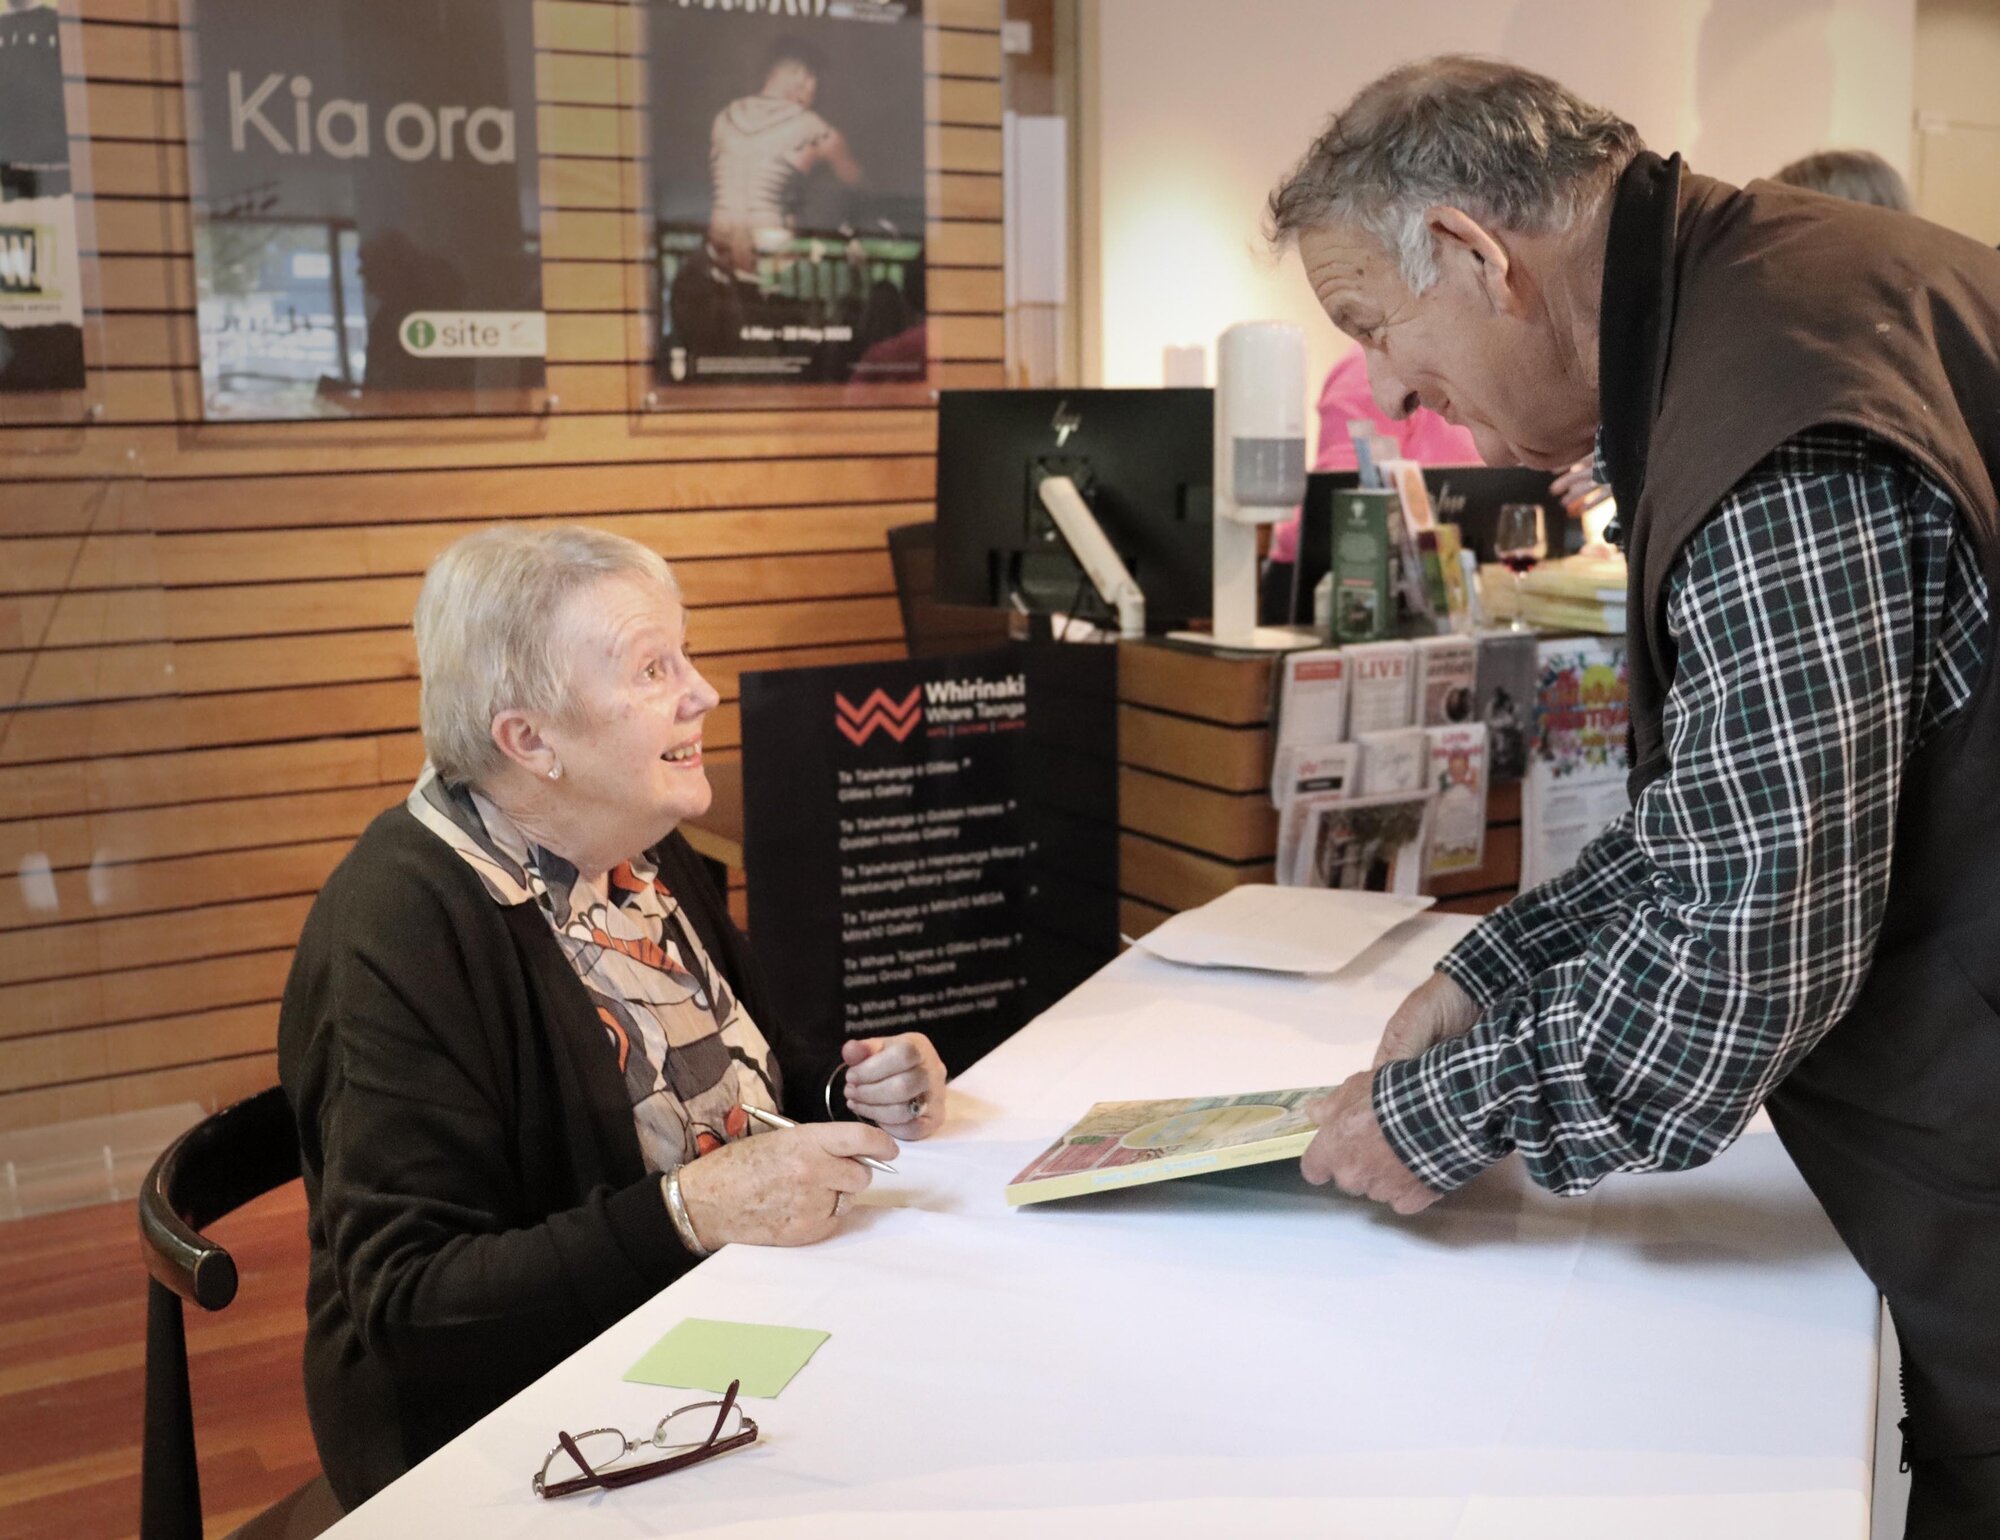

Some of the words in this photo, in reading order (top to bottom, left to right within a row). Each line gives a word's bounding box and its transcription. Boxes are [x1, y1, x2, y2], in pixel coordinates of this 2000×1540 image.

[228, 70, 370, 159] Kia
[384, 101, 516, 165] ora
[442, 319, 500, 348] site
[1357, 660, 1404, 680] LIVE
[925, 673, 1026, 704] Whirinaki
[925, 705, 973, 723] Whare
[975, 701, 1026, 719] Taonga
[838, 771, 853, 784] Te
[838, 787, 872, 802] Gillies
[874, 783, 914, 798] Gallery
[840, 819, 854, 833] Te
[926, 808, 965, 822] Golden
[966, 804, 1003, 816] Homes
[839, 836, 880, 851] Golden
[881, 832, 920, 845] Homes
[922, 826, 960, 841] Gallery
[841, 865, 855, 878] Te
[944, 868, 982, 882] Gallery
[842, 911, 857, 925] Te
[886, 921, 924, 937] Gallery
[844, 957, 858, 970] Te
[845, 1002, 859, 1015] Te
